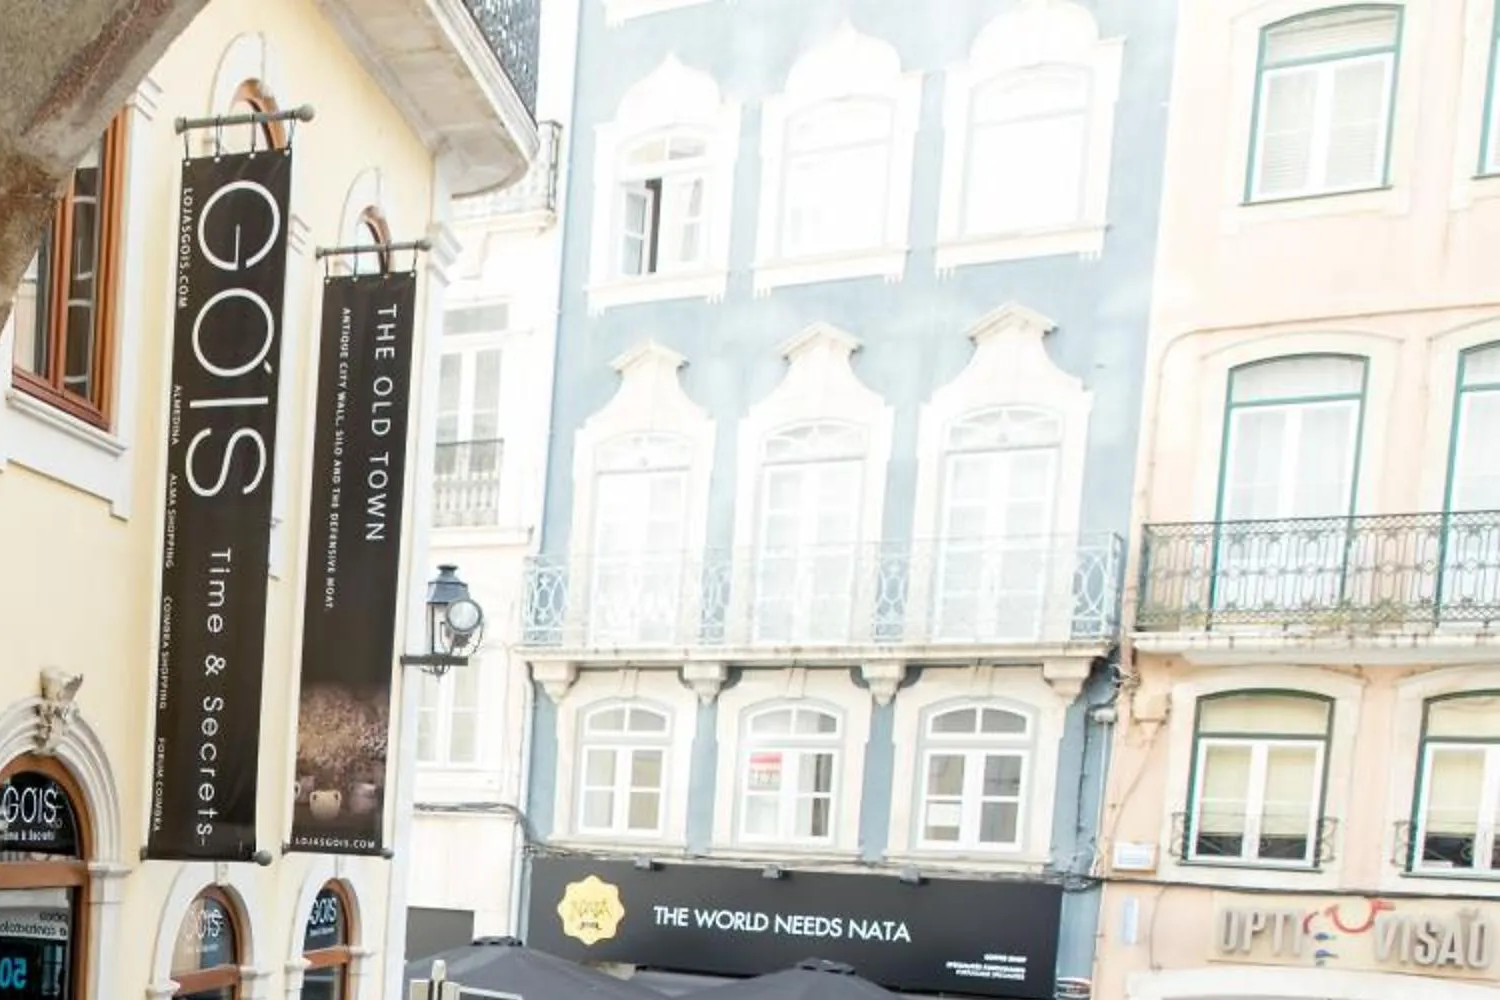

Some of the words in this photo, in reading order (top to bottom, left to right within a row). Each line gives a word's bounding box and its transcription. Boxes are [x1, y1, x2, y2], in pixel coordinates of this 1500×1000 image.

[177, 187, 194, 309] LOJASGOIS.COM
[340, 307, 351, 358] ANTIQUE
[374, 303, 397, 360] THE
[338, 361, 349, 390] CITY
[171, 384, 183, 445] ALMEDINA
[371, 376, 393, 437] OLD
[365, 451, 389, 540] TOWN
[207, 547, 232, 633] Time
[205, 654, 227, 676] &
[653, 905, 690, 927] THE
[693, 909, 769, 932] WORLD
[774, 914, 843, 938] NEEDS
[848, 920, 913, 943] NATA
